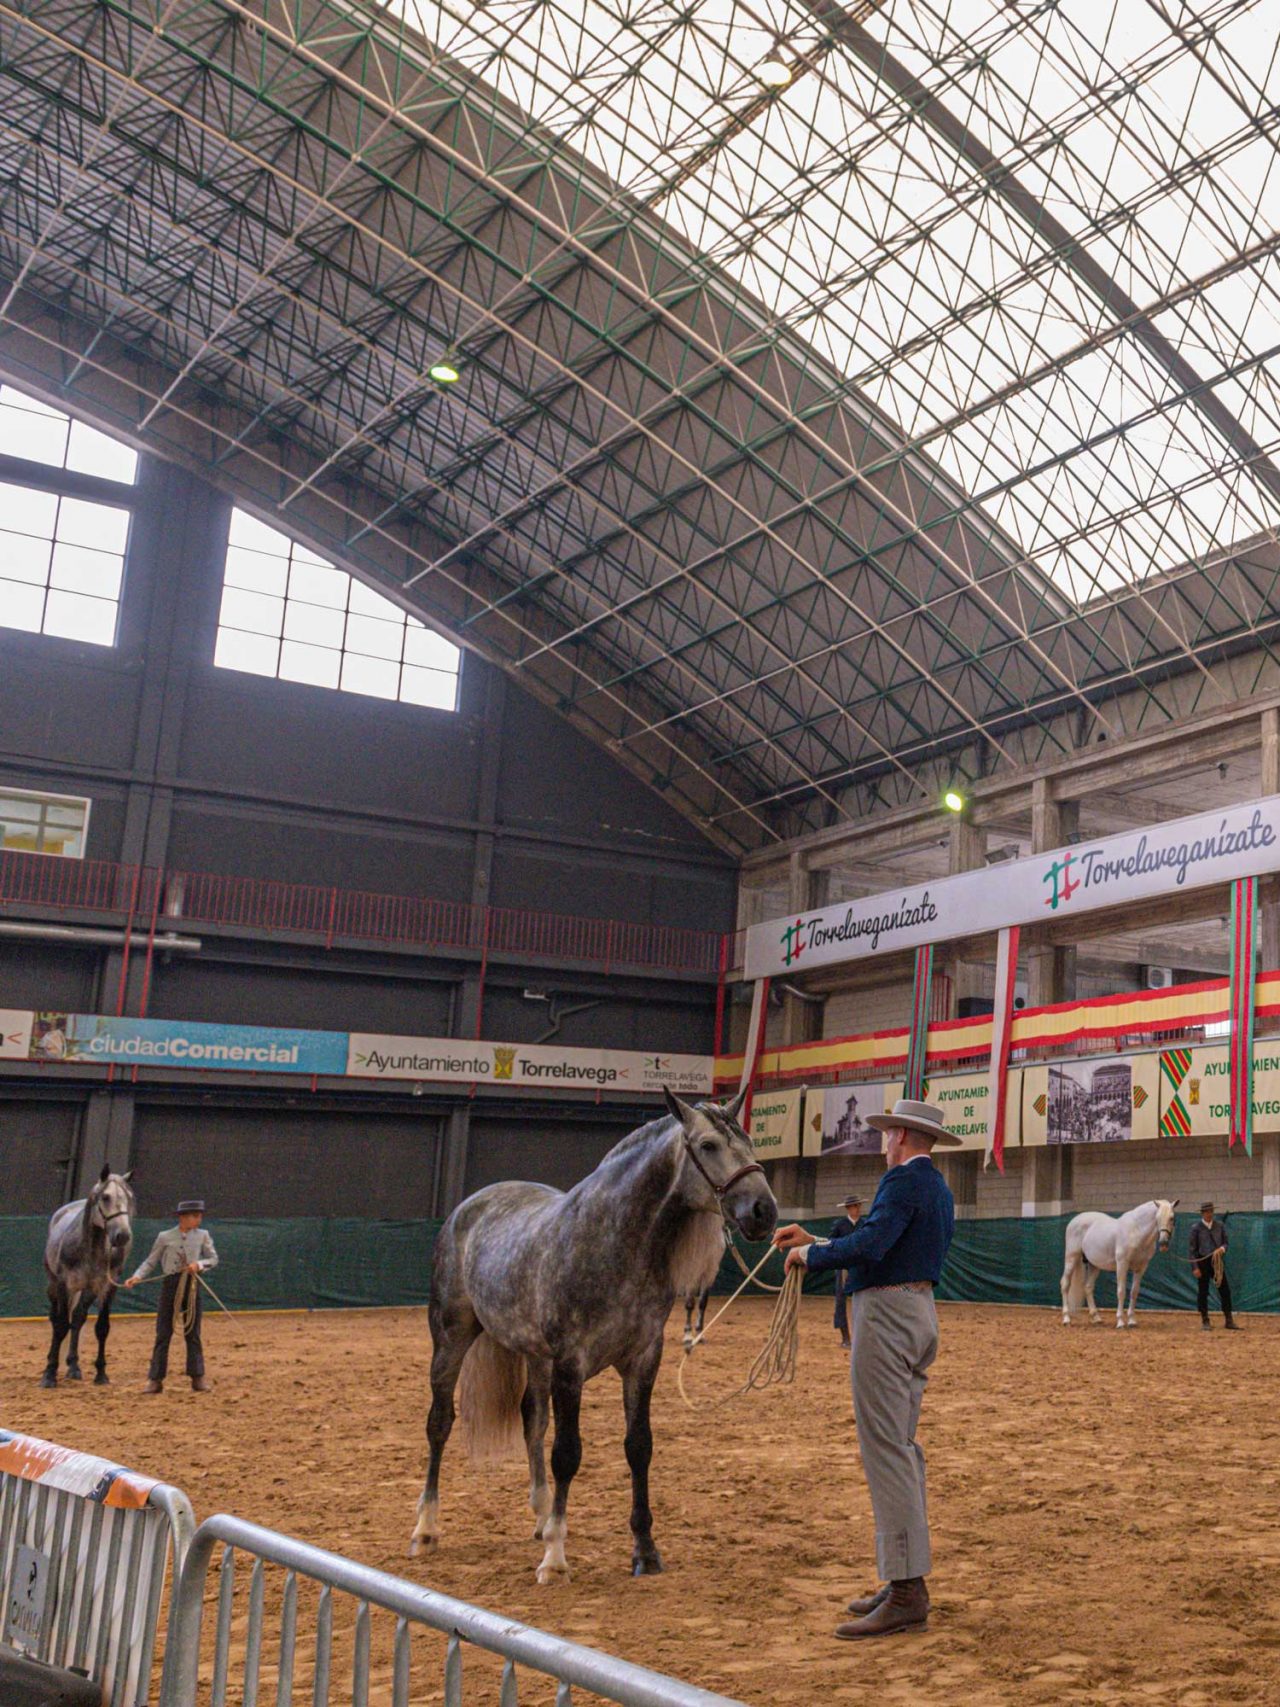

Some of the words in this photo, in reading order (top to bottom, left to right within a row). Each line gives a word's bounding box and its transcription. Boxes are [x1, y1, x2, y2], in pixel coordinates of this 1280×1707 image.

[90, 1035, 299, 1063] ciudadComercial
[366, 1050, 490, 1076] Ayuntamiento
[519, 1060, 618, 1083] Torrelavega
[643, 1070, 708, 1081] TORRELAVEGA
[964, 1105, 974, 1117] DE
